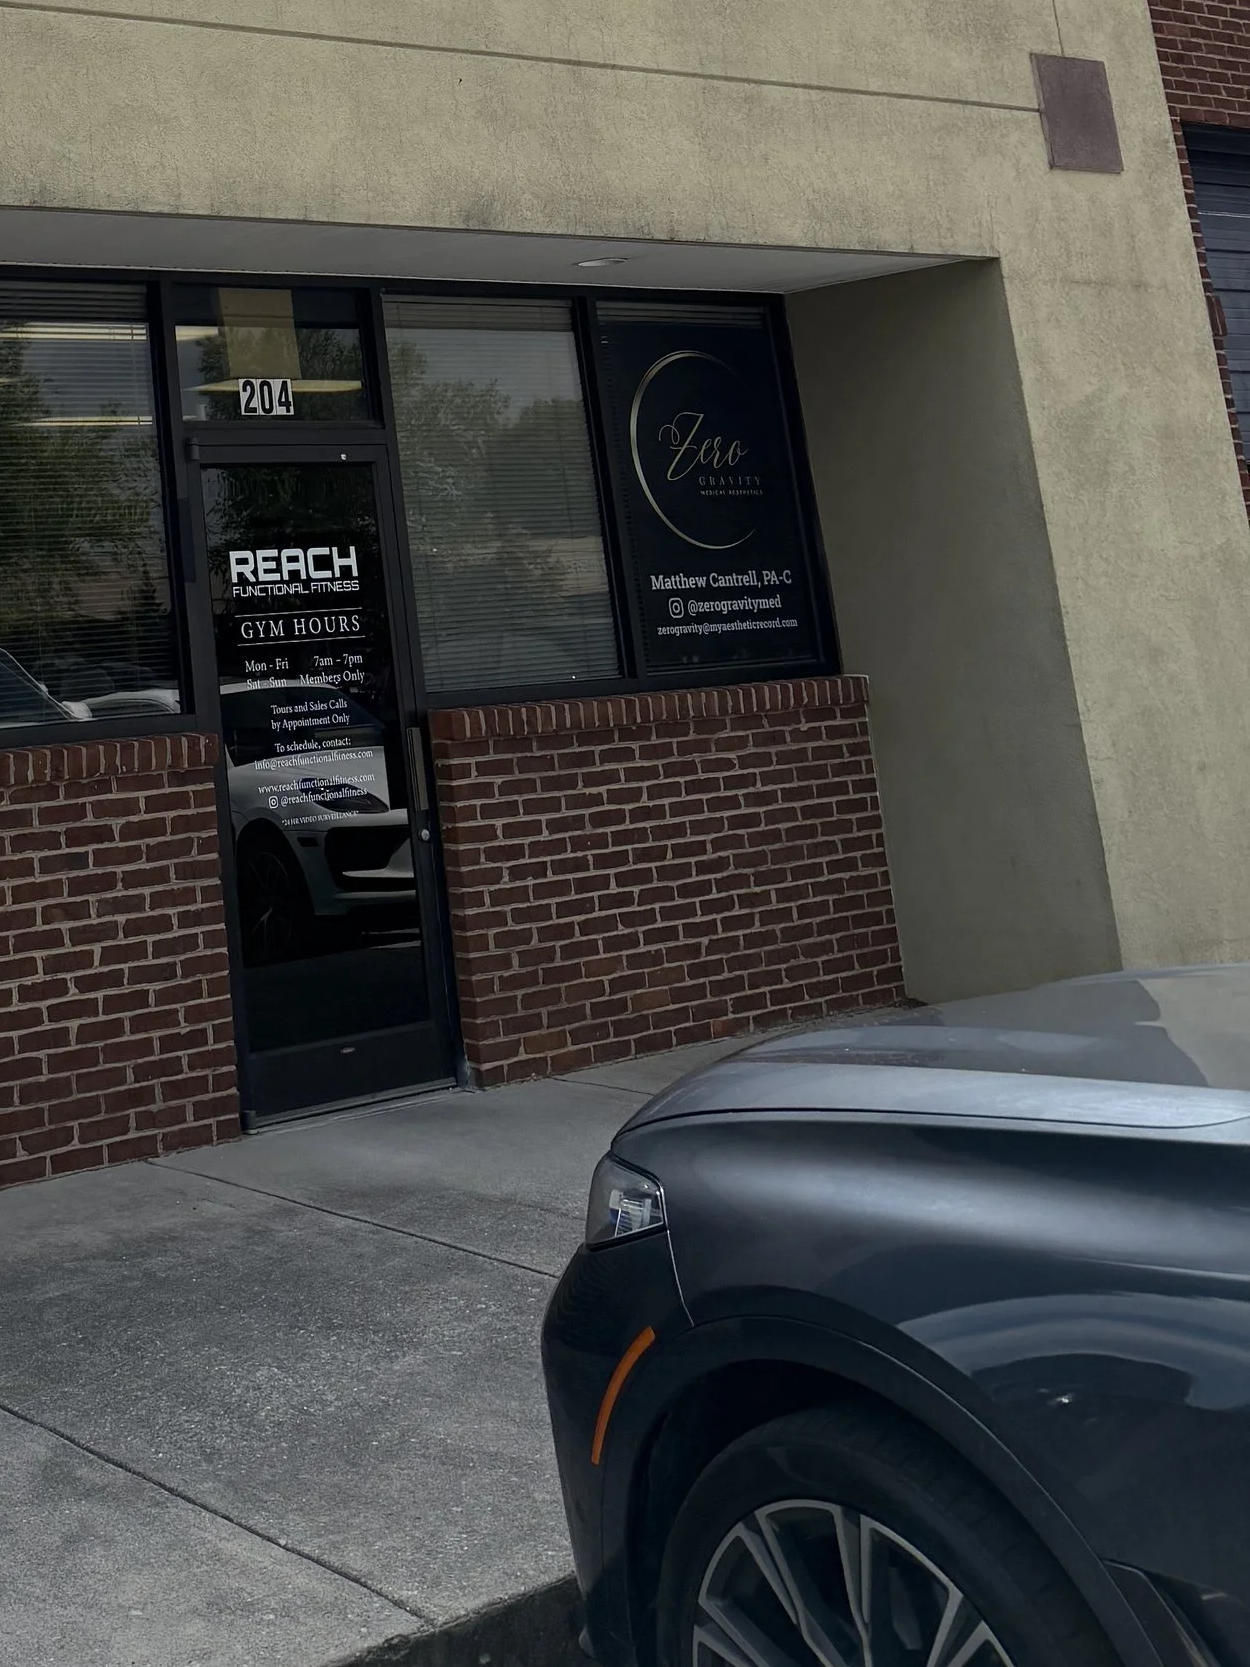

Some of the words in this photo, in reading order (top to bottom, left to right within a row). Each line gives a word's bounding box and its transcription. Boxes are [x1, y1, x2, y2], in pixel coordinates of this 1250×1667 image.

[241, 379, 292, 414] 204
[658, 411, 748, 481] Zero
[698, 475, 761, 486] GRAVITY
[229, 545, 359, 583] REACH
[232, 582, 309, 598] FUNCTIONAL
[311, 580, 360, 593] FITNESS
[650, 573, 707, 590] Matthew
[709, 570, 762, 588] Cantrell,
[762, 569, 792, 585] PA-C
[687, 594, 782, 616] @zerogravitymed
[240, 619, 284, 639] GYM
[294, 614, 361, 635] HOURS
[657, 617, 798, 636] zerogravity@myaestheticrecord.com
[245, 660, 267, 672] Mon
[275, 658, 289, 670] Fri
[313, 655, 334, 667] 7am
[342, 653, 363, 668] 7pm
[269, 677, 287, 687] Sun
[299, 672, 342, 685] Members
[342, 669, 365, 683] Only
[270, 704, 293, 715] Tours
[294, 702, 308, 713] and
[309, 700, 328, 711] Sales
[328, 698, 348, 709] Calls
[271, 719, 281, 732] by
[282, 715, 331, 731] Appointment
[331, 713, 350, 725] Only
[274, 743, 285, 753] To
[286, 739, 321, 752] schedule,
[322, 737, 352, 749] contact:
[254, 749, 374, 771] info@reachfunctionalfitness.com
[258, 774, 375, 794] www.reachfunctionalfitness.com
[280, 787, 368, 808] @reachfunctionalfitness
